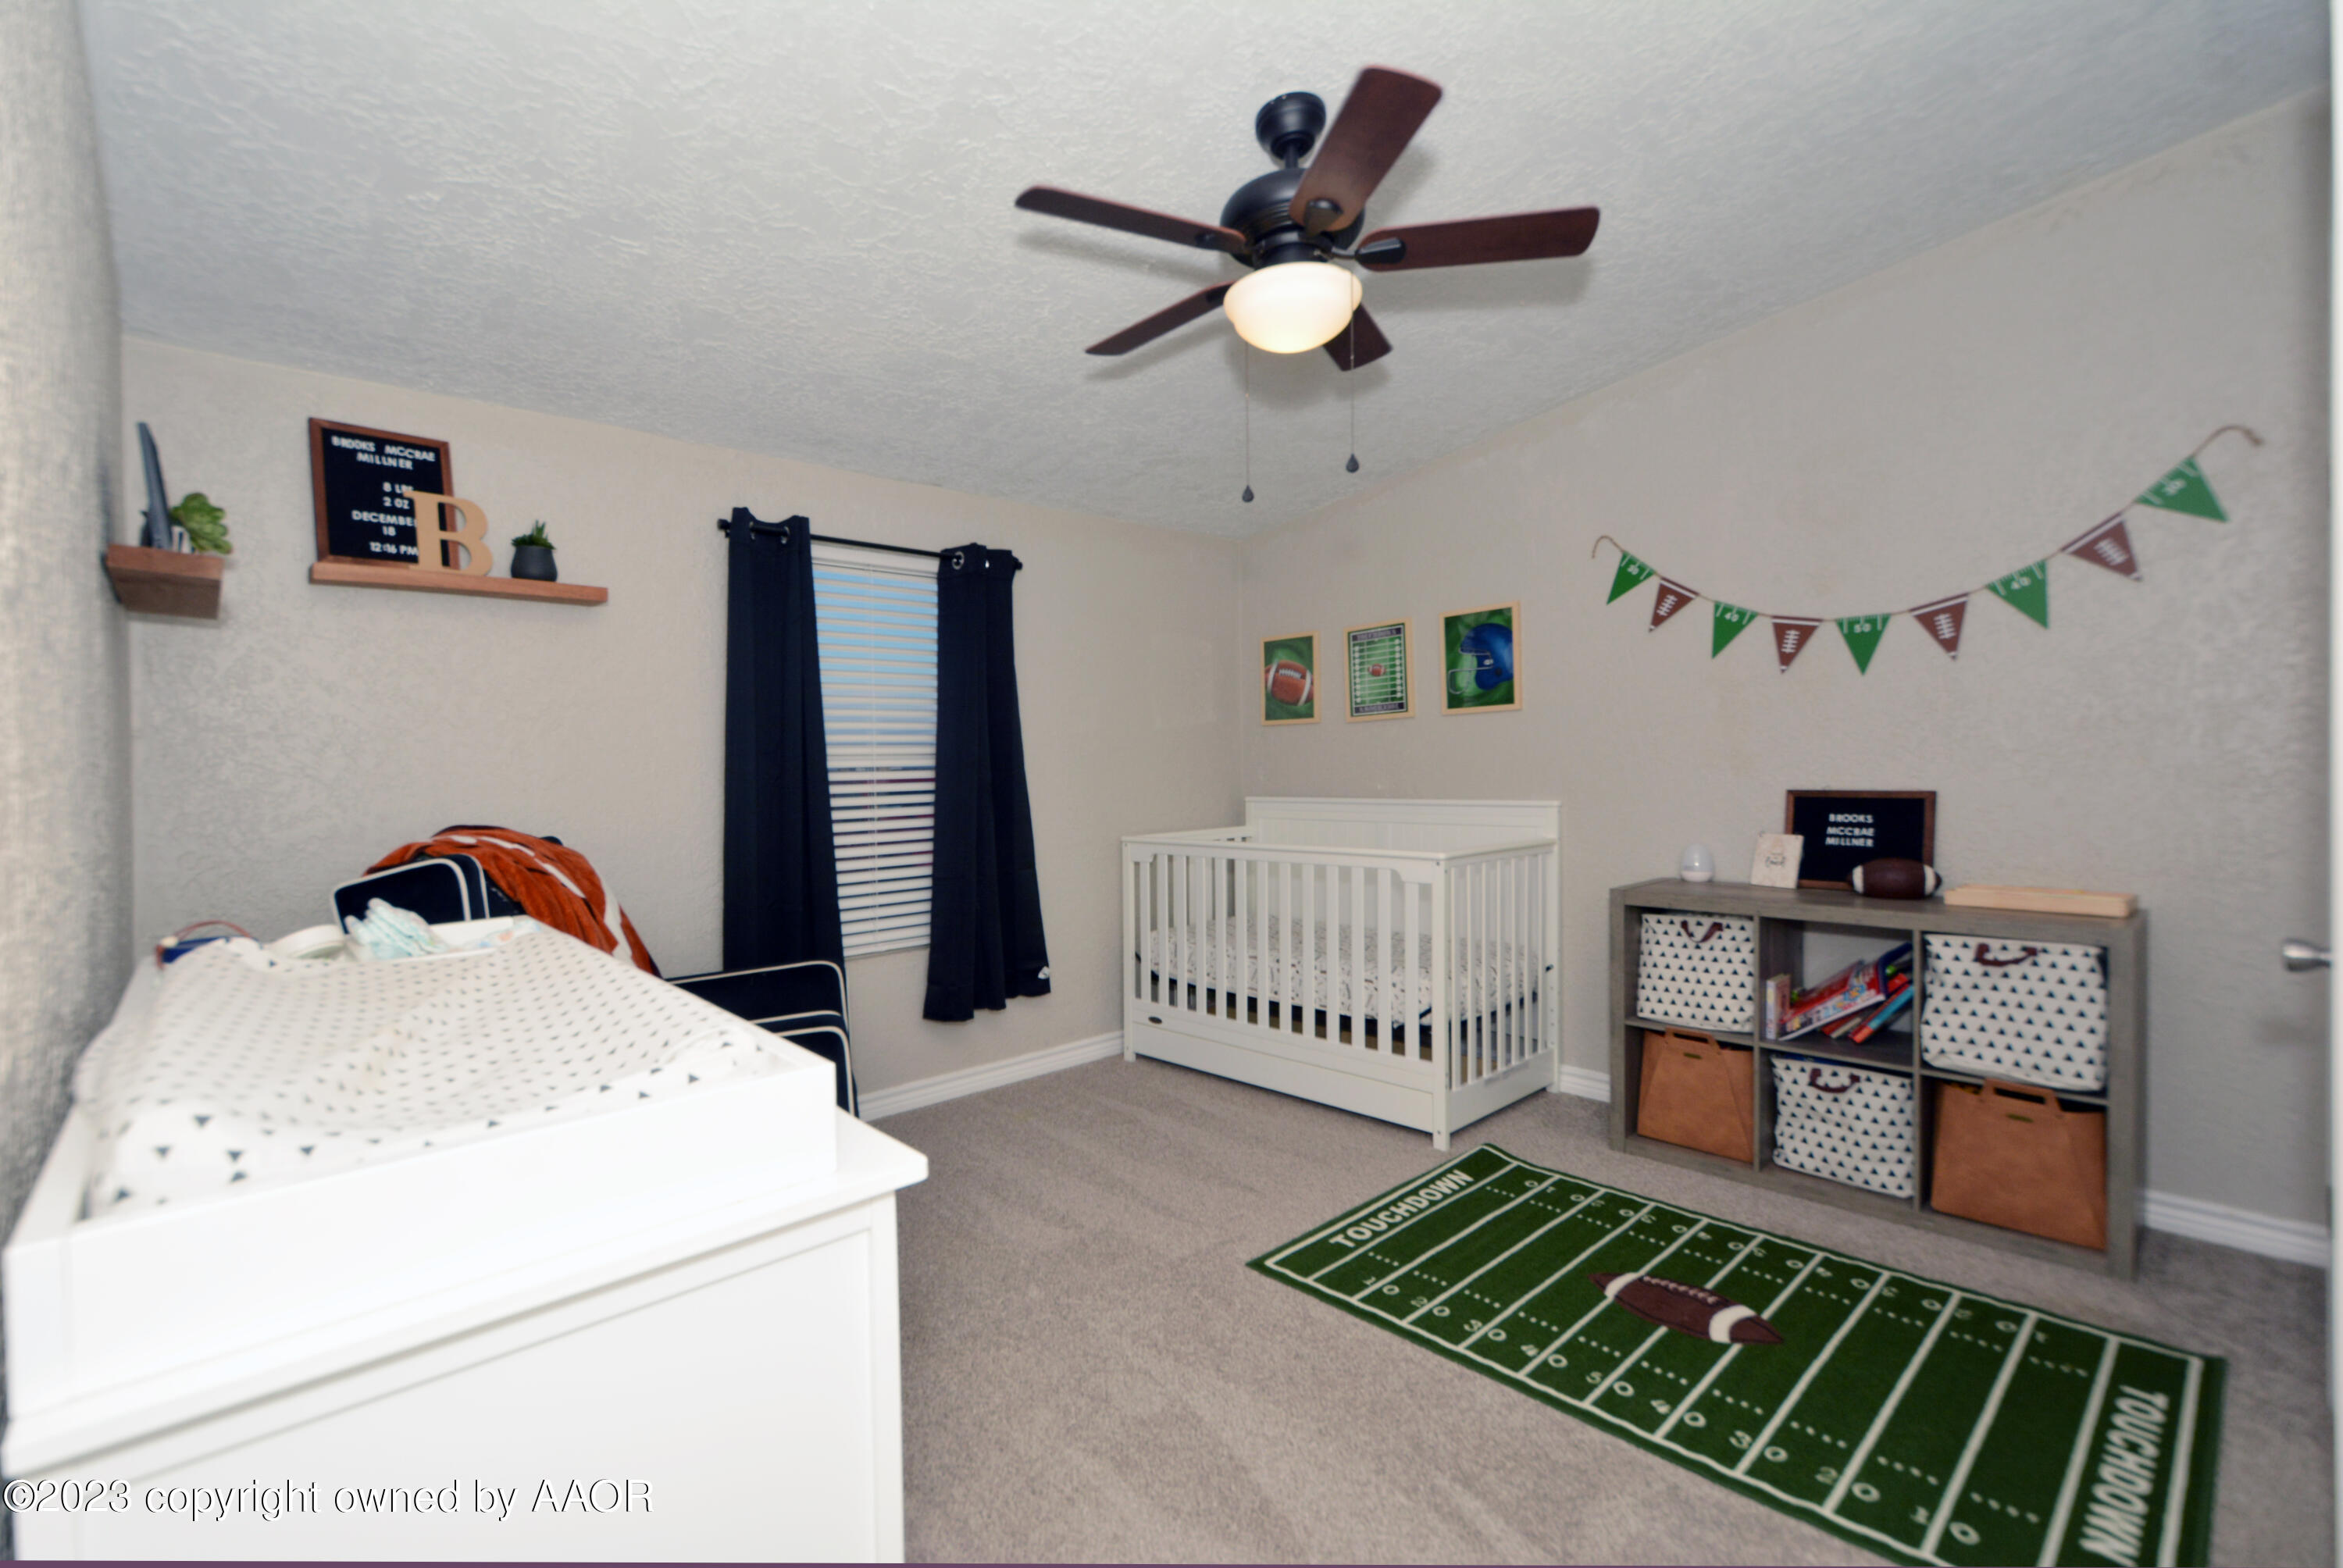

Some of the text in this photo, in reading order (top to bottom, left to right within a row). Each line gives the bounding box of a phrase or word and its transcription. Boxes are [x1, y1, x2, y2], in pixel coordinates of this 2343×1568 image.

[331, 436, 435, 461] BROOKS MCCRAE
[356, 452, 413, 469] MILLNER
[383, 497, 410, 509] 2 OZ
[351, 510, 417, 528] DECEMBE
[383, 526, 396, 536] 18
[404, 490, 493, 576] B
[1724, 611, 1740, 622] 40
[1853, 623, 1872, 633] 50
[1828, 813, 1874, 823] BROOKS
[1826, 826, 1875, 836] MCCRAE
[1824, 836, 1874, 847] MILLNER
[1328, 1169, 1475, 1248] TOUCHDOWN
[2078, 1384, 2170, 1567] TOUCHDOWN
